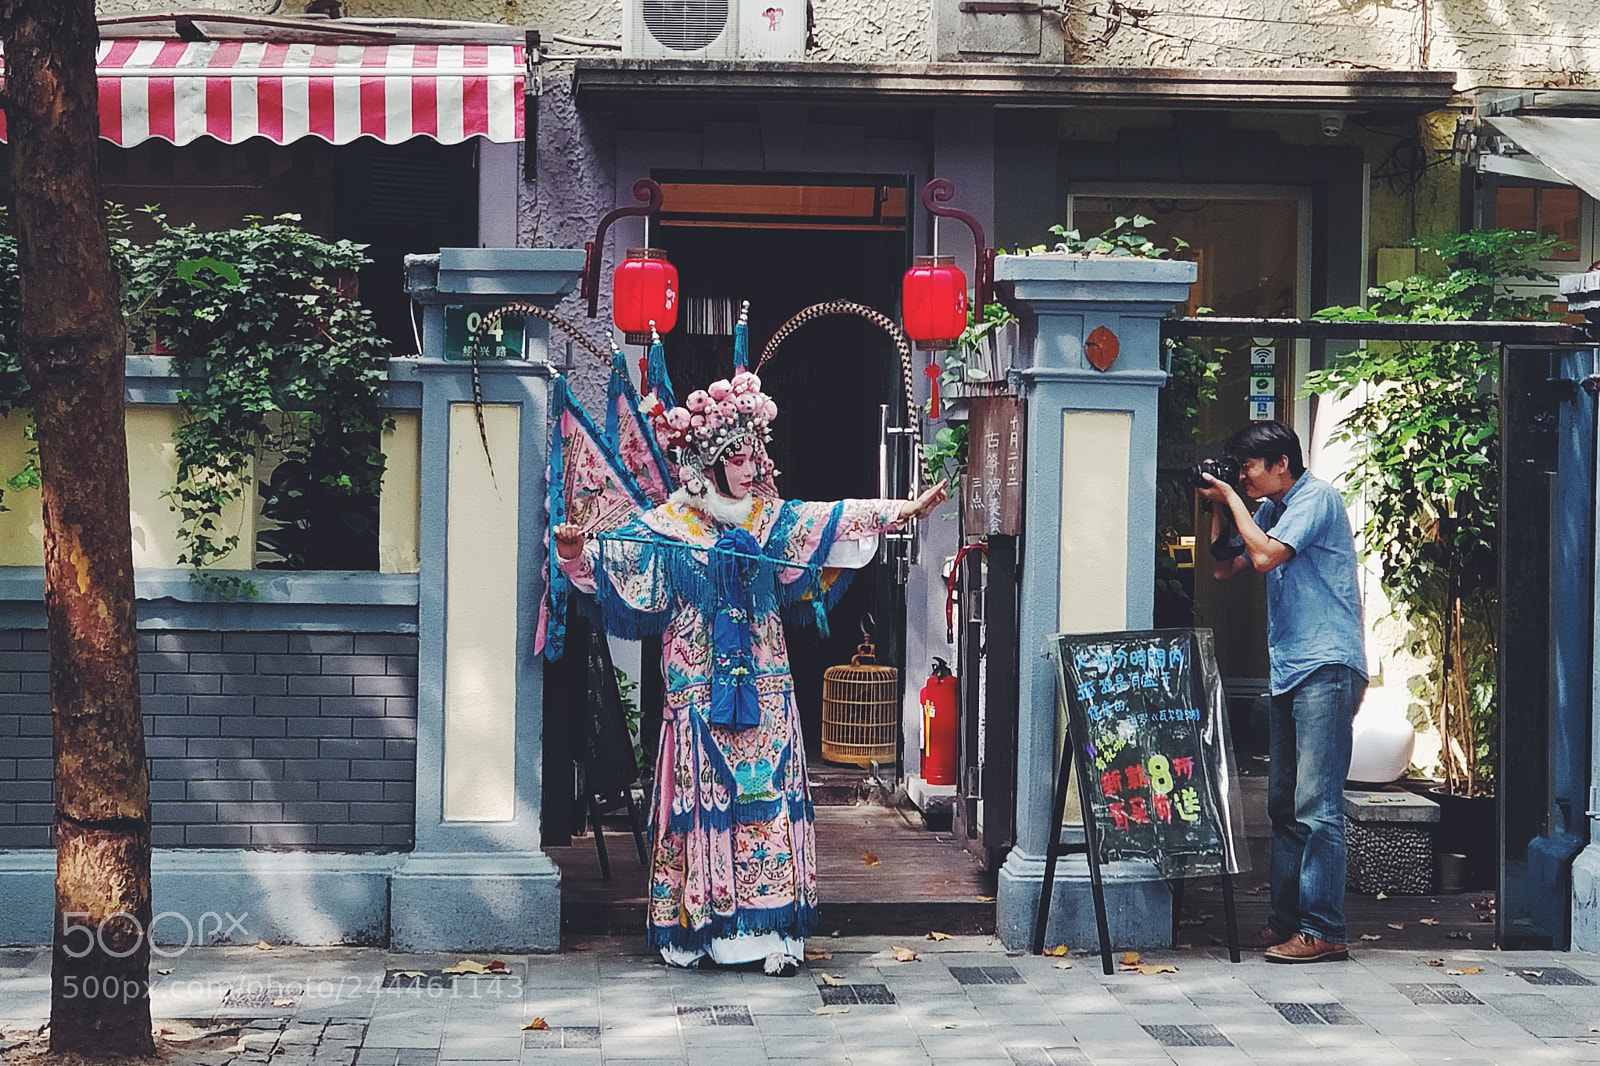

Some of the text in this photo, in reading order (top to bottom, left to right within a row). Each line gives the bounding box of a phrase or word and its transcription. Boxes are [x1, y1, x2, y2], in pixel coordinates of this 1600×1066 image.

[467, 312, 503, 342] 94
[462, 345, 507, 357] 绍兴路
[1006, 416, 1019, 486] 十月二十二
[971, 477, 985, 509] 三点
